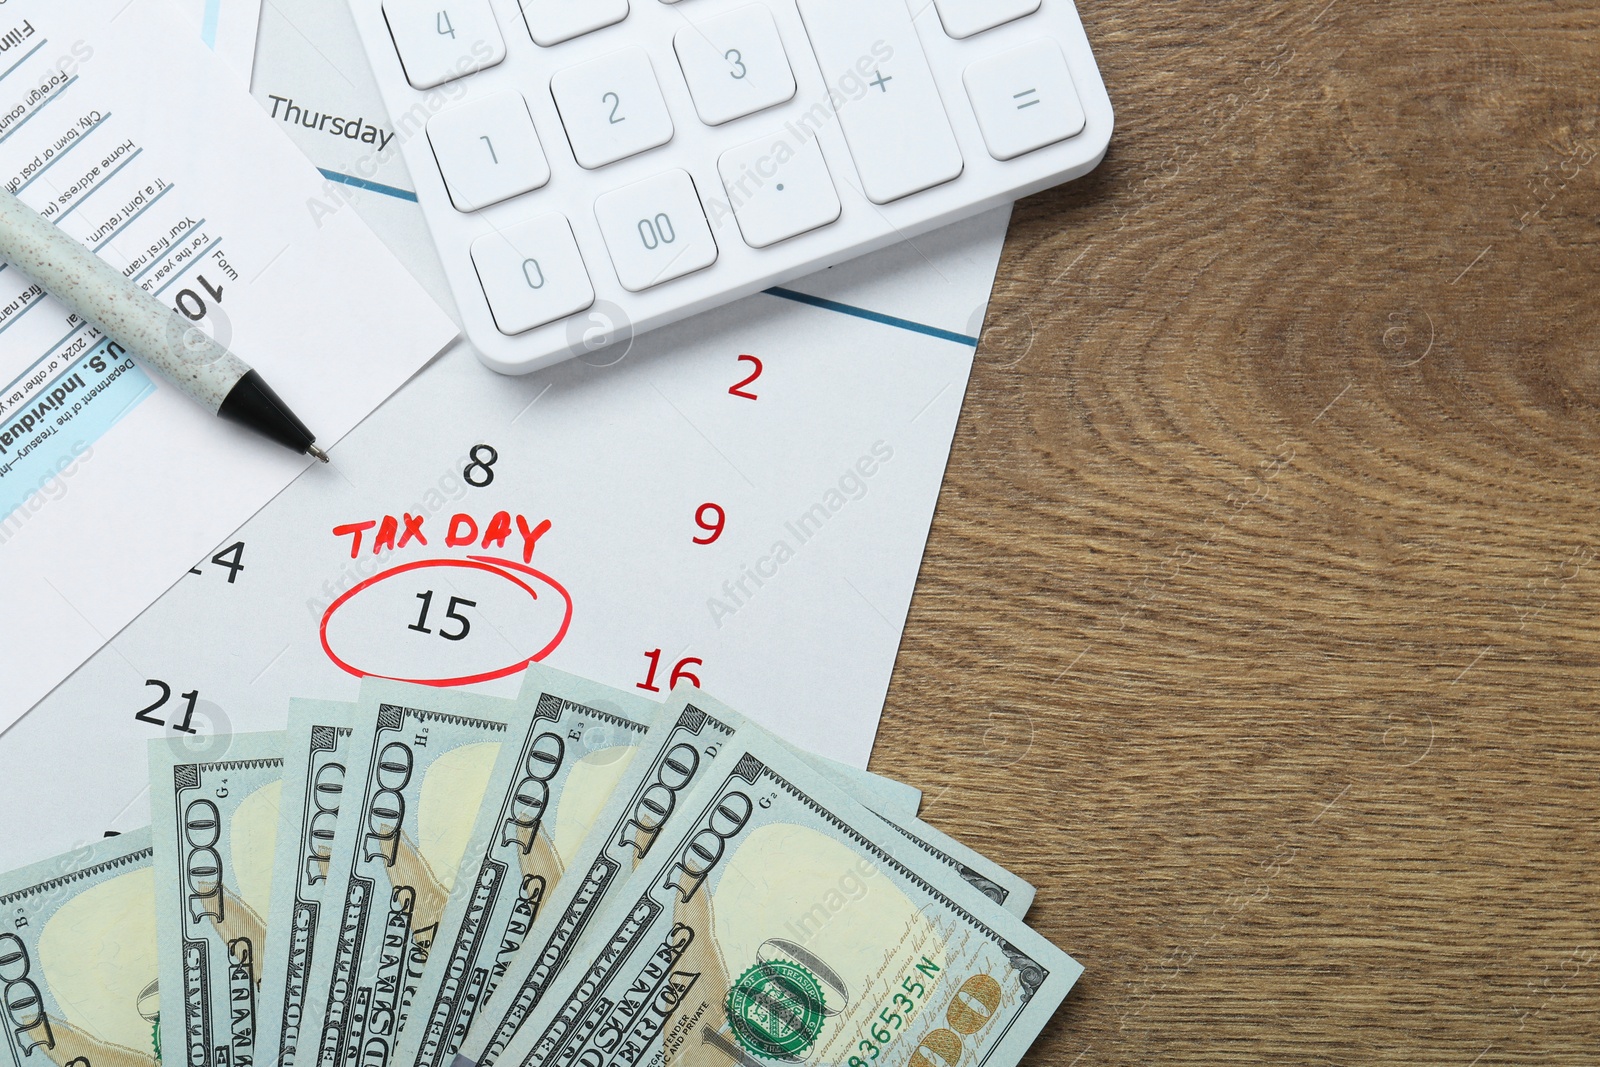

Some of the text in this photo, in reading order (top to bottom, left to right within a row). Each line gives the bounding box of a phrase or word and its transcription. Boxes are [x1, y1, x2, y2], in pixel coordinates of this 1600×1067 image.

[0, 19, 35, 52] Filin
[437, 11, 455, 39] 4
[725, 49, 746, 79] 3
[26, 70, 68, 106] Foreign
[77, 111, 100, 129] City,
[269, 95, 395, 151] Thursday
[602, 92, 625, 124] 2
[43, 149, 54, 161] or
[54, 129, 79, 150] town
[101, 139, 135, 167] Home
[480, 136, 498, 164] 1
[20, 156, 43, 180] post
[59, 167, 100, 204] address
[86, 178, 165, 242] If a joint return,
[170, 217, 196, 239] Your
[192, 233, 209, 249] For
[638, 213, 675, 250] 00
[147, 237, 169, 258] first
[175, 248, 192, 262] the
[155, 259, 176, 281] year
[212, 250, 238, 281] Form
[522, 258, 544, 289] 0
[173, 274, 224, 321] 10
[62, 338, 86, 361] 2024,
[83, 340, 126, 372] U.S.
[24, 371, 46, 393] other
[48, 362, 57, 372] or
[81, 356, 135, 405] Department
[728, 355, 762, 400] 2
[7, 392, 24, 406] tax
[72, 403, 81, 415] of
[57, 412, 73, 425] the
[463, 444, 498, 487] 8
[333, 511, 551, 567] TAX DAY
[693, 503, 725, 545] 9
[408, 590, 476, 641] 15
[135, 680, 198, 734] 21
[364, 742, 414, 867] 100
[501, 731, 565, 855] 100
[618, 742, 700, 859] 100
[184, 798, 224, 924] 100
[663, 790, 754, 904] 100
[441, 865, 499, 1001] DOLLARS
[530, 861, 610, 987] DOLLARS
[327, 882, 368, 1023] DOLLARS
[364, 882, 420, 1036] STATES
[562, 901, 653, 1022] DOLLARS
[920, 956, 941, 976] N
[590, 918, 698, 1055] STATES
[742, 973, 756, 988] OF
[661, 1013, 689, 1049] TENDER
[668, 1035, 684, 1055] AND
[681, 1000, 709, 1035] PRIVATE
